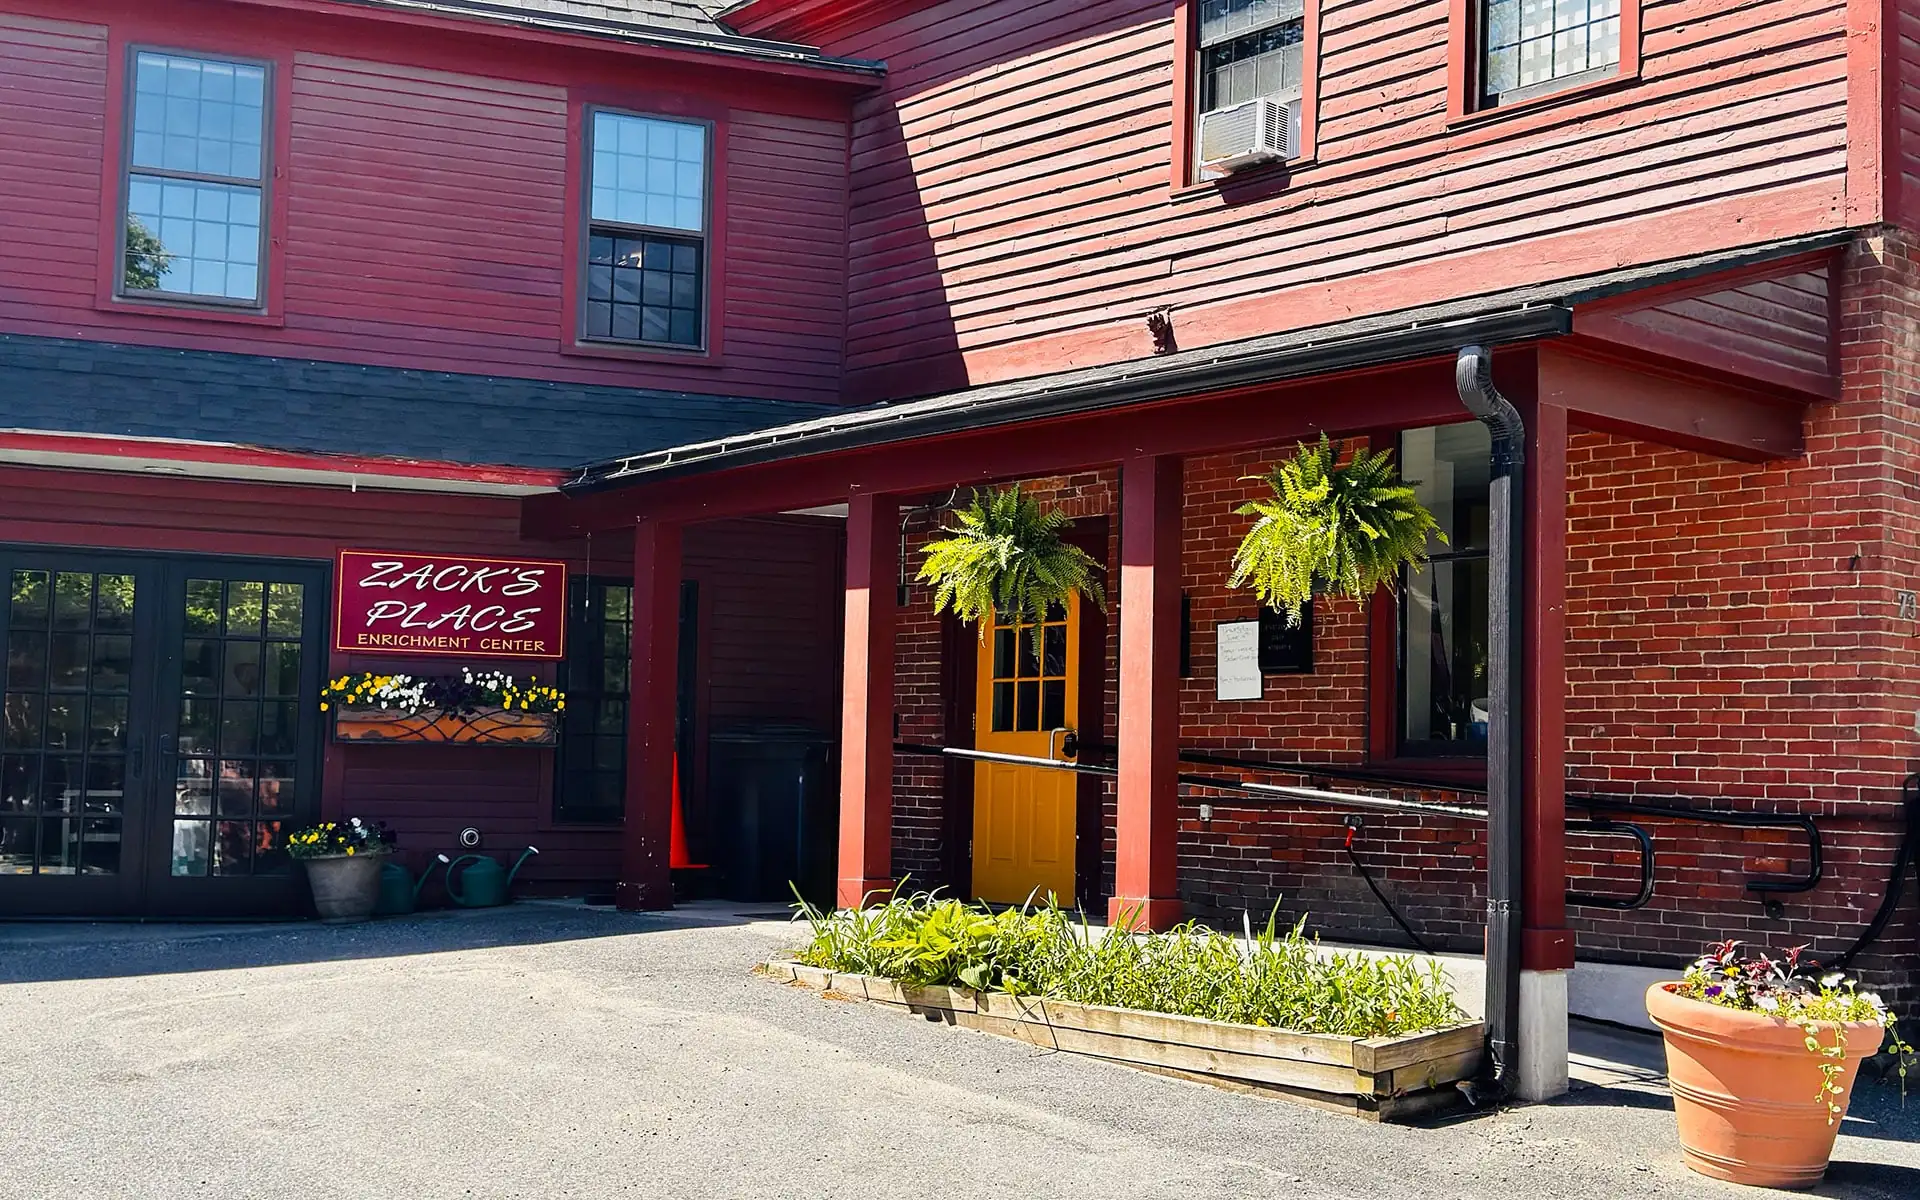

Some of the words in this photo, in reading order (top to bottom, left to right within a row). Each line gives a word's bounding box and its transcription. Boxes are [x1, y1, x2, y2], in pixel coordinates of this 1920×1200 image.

[359, 561, 545, 596] ZACK'S
[366, 600, 542, 633] PLACE
[1898, 592, 1916, 619] 73
[358, 633, 471, 649] ENRICHMENT
[480, 638, 545, 652] CENTER
